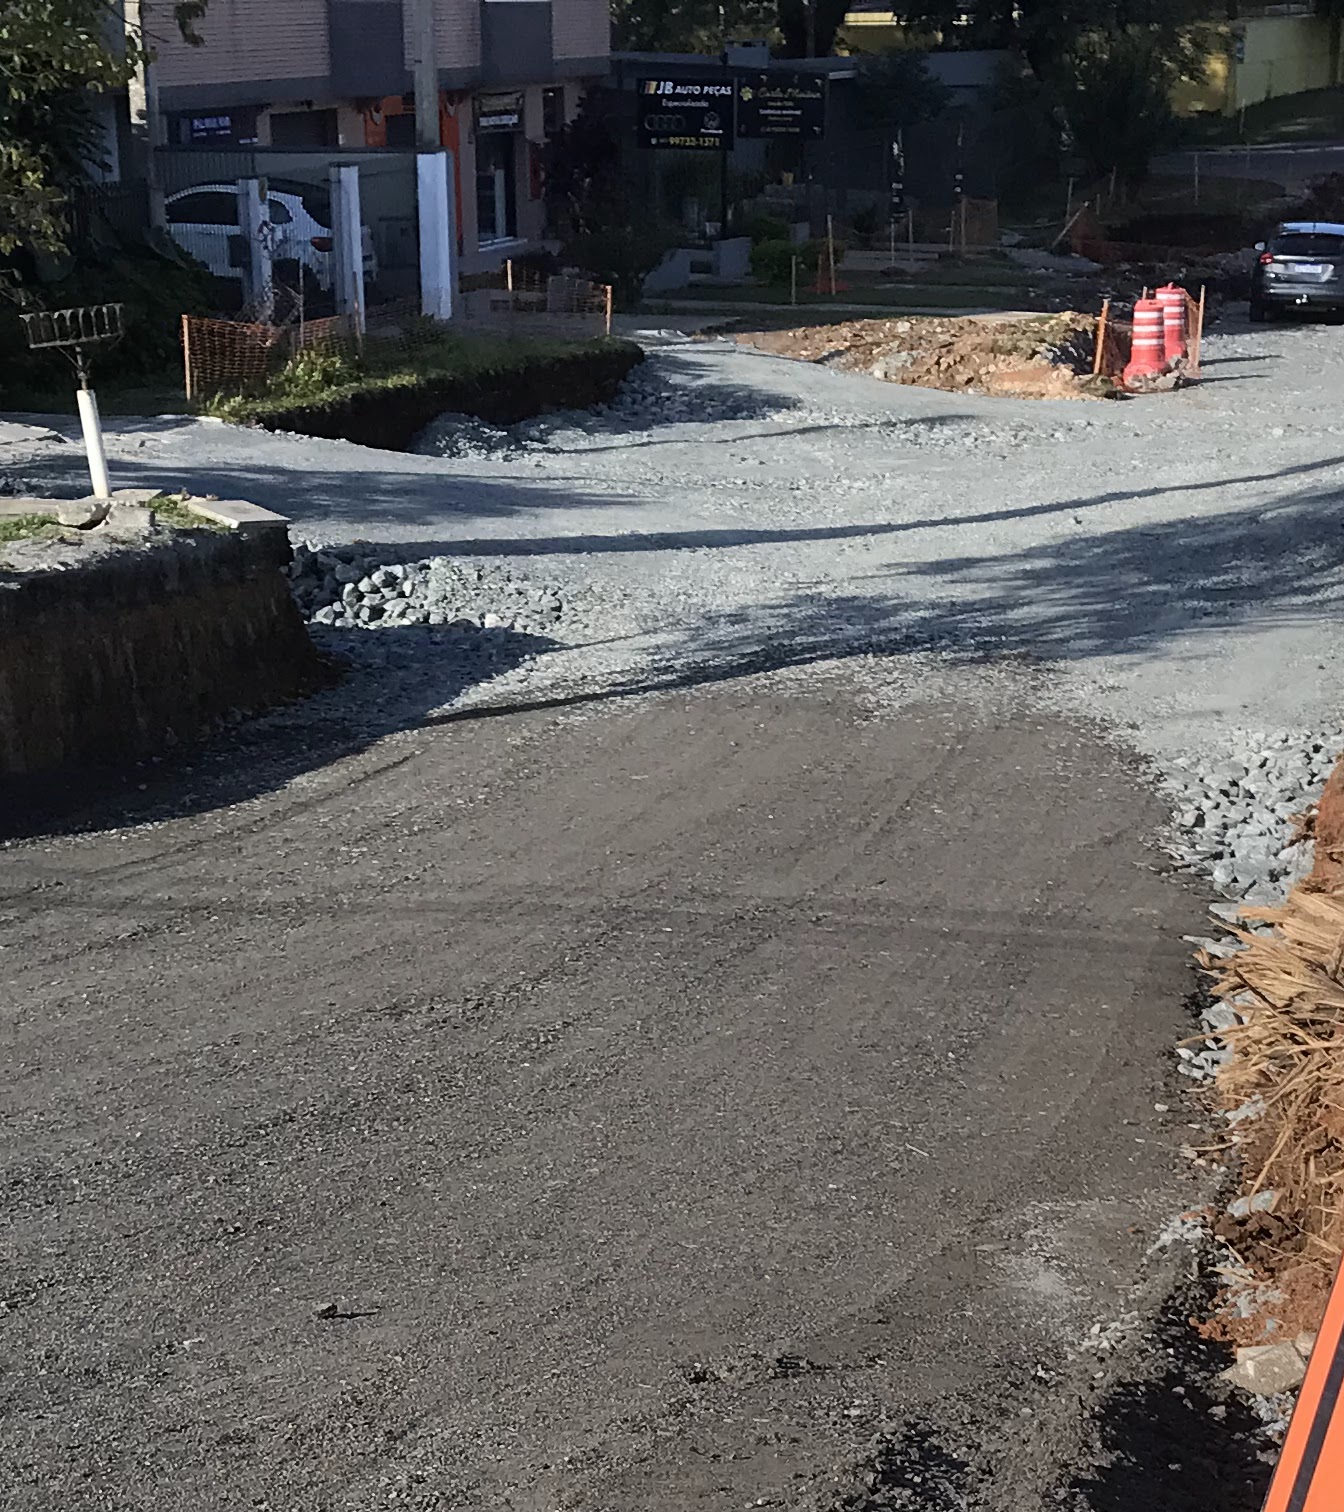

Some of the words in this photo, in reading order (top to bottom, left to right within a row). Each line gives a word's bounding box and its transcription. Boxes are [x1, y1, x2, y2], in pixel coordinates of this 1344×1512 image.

[657, 81, 673, 94] JB
[675, 86, 701, 94] AUTO
[703, 86, 732, 96] PEÇAS
